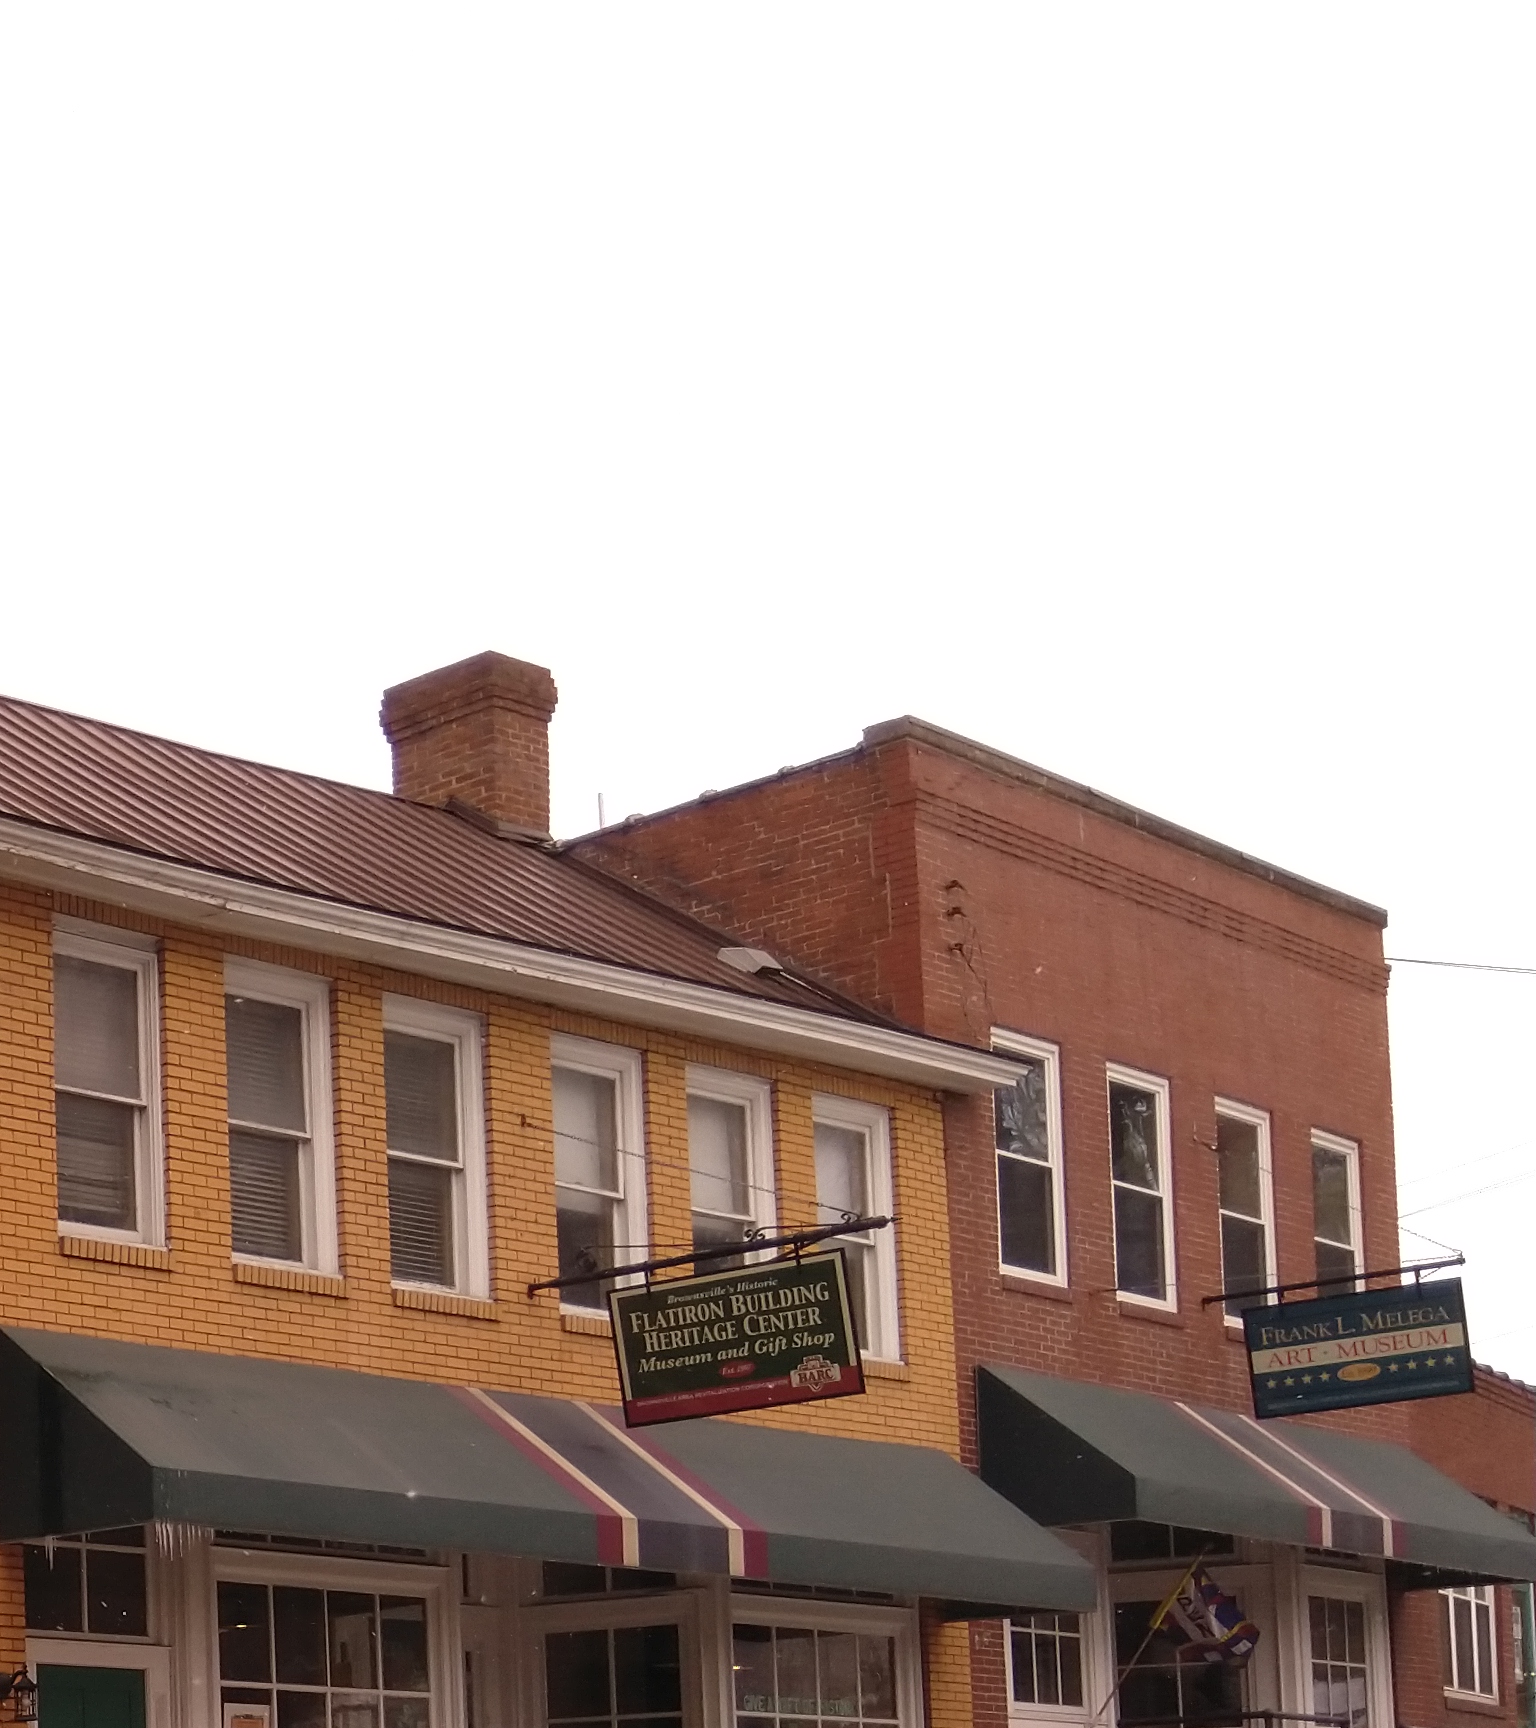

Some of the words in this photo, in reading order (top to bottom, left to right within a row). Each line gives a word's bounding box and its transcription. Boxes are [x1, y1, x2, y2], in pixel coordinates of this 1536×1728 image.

[737, 1277, 778, 1292] Historic
[629, 1300, 725, 1333] FLATIRON
[729, 1282, 830, 1316] BUILDING
[1261, 1322, 1332, 1346] FRANK
[1335, 1316, 1356, 1335] L.
[1360, 1306, 1450, 1331] MELEGA
[643, 1320, 738, 1353] HERITAGE
[743, 1307, 822, 1336] CENTER
[1267, 1347, 1318, 1368] ART
[1336, 1329, 1449, 1359] MUSEUM
[638, 1351, 713, 1373] Museum
[717, 1342, 749, 1360] and
[754, 1336, 788, 1357] Gift
[791, 1330, 835, 1349] Shop
[797, 1368, 835, 1384] BARC
